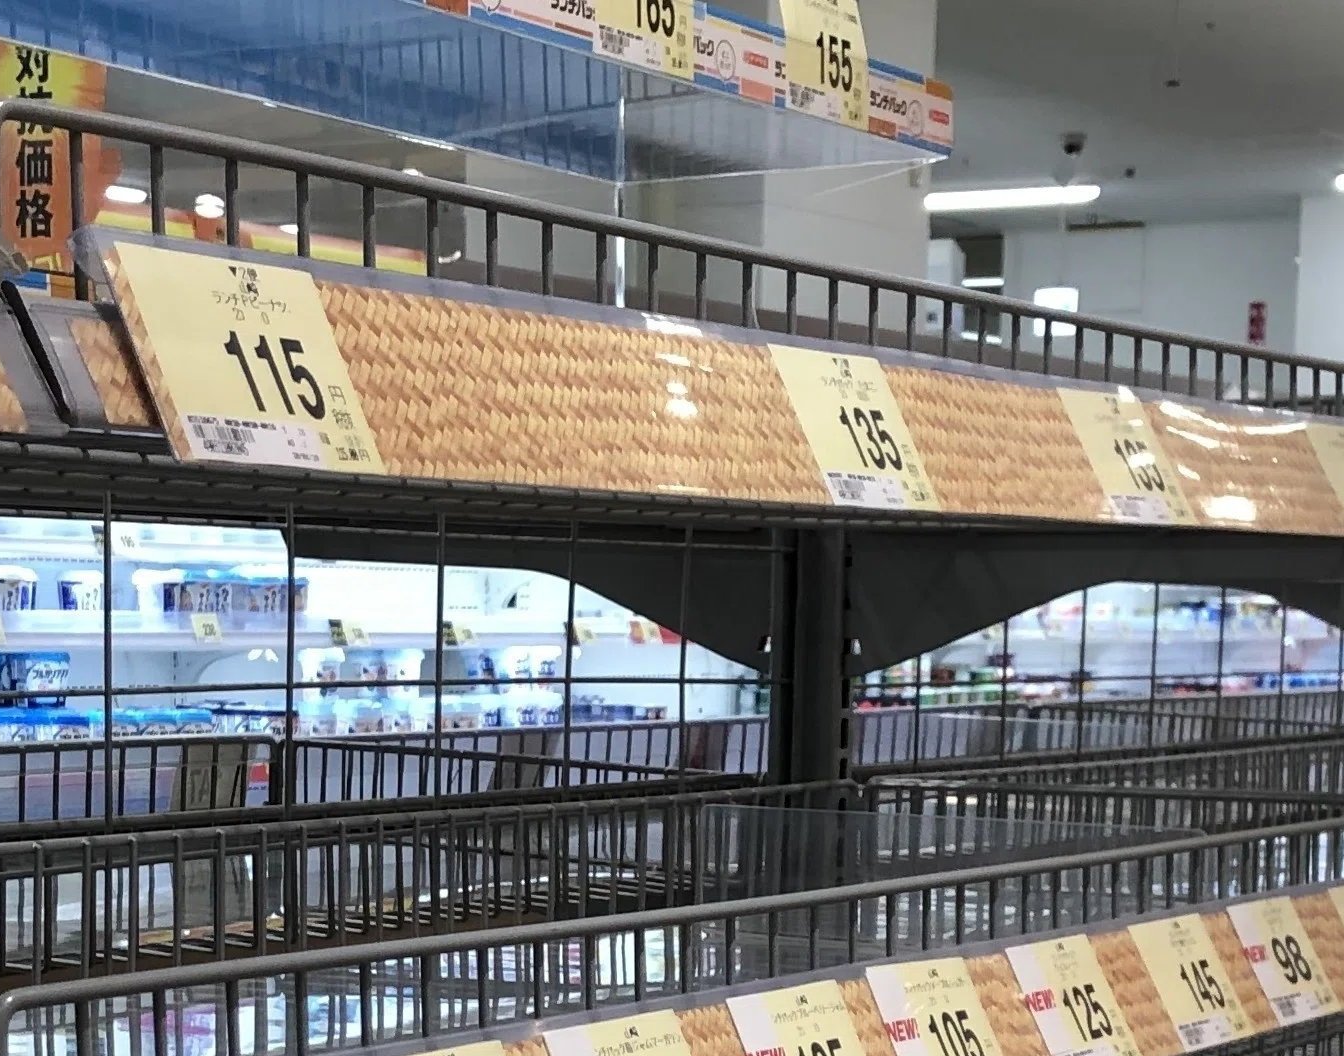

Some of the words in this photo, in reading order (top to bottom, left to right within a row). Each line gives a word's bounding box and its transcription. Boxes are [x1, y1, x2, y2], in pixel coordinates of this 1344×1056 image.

[816, 31, 854, 92] 155
[223, 330, 326, 420] 115
[839, 405, 904, 471] 135
[1178, 958, 1226, 1014] 145
[1271, 933, 1312, 986] 98
[1062, 983, 1114, 1043] 125
